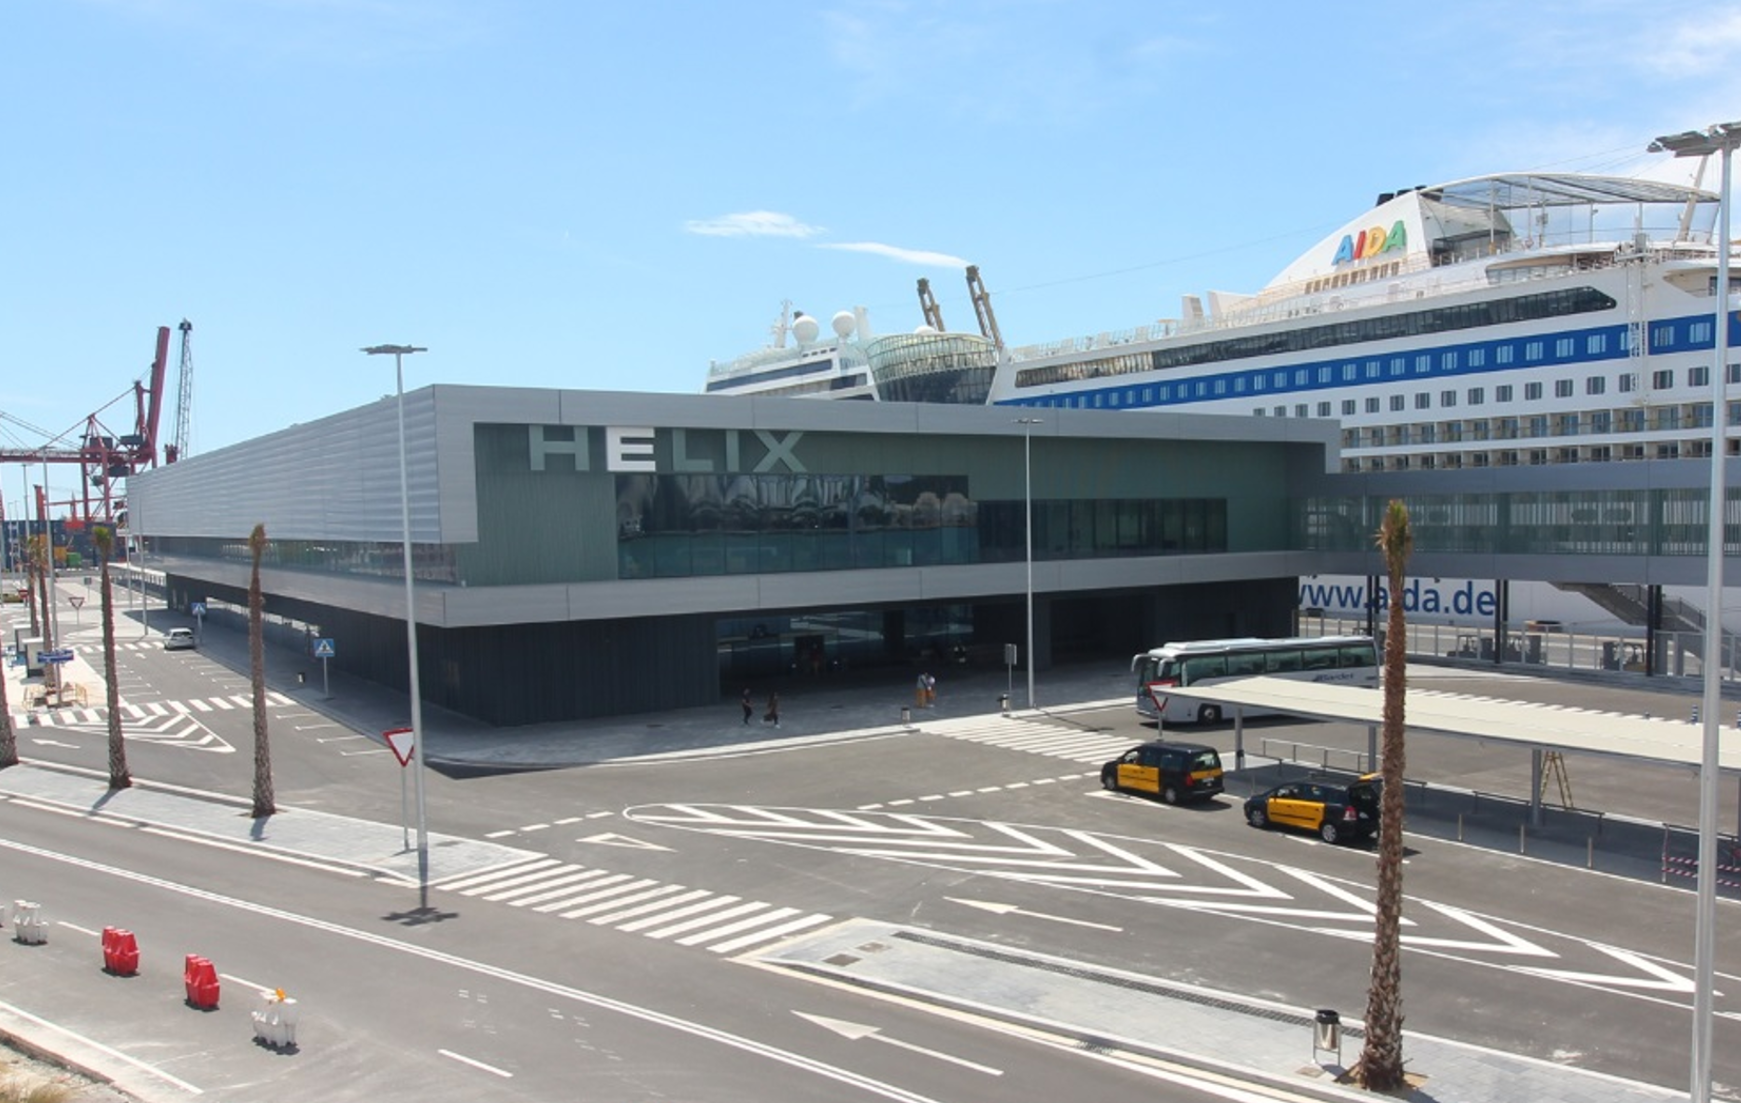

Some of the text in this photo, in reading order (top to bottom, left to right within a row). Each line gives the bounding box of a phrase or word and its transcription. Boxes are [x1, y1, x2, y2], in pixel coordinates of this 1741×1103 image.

[1331, 220, 1407, 266] AIDA
[529, 424, 807, 472] HELIX
[1299, 579, 1496, 616] ww.ada.de
